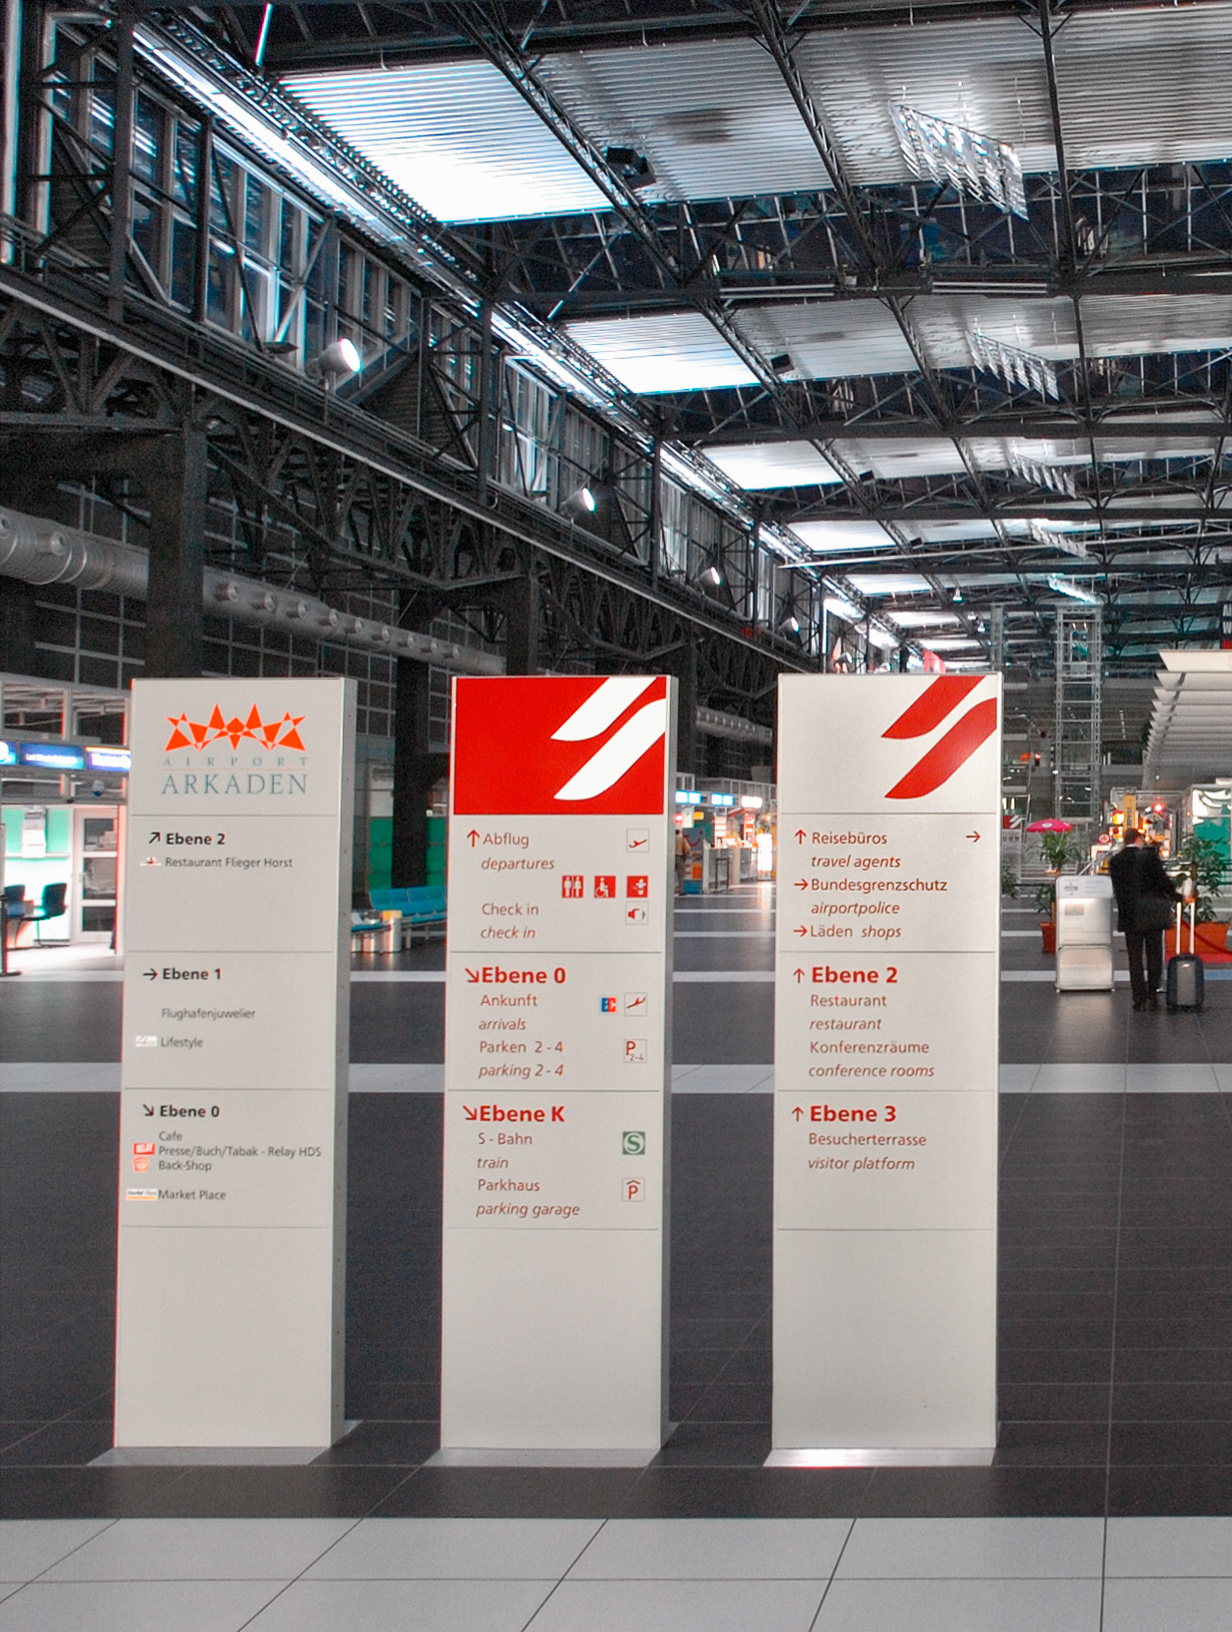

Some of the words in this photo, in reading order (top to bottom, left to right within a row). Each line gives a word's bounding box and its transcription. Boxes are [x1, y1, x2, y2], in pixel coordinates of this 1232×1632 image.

[163, 757, 307, 766] AIRPORT
[162, 774, 307, 794] ARKADEN
[166, 833, 212, 845] Ebene
[217, 833, 225, 845] 2
[483, 832, 529, 849] Abflug
[812, 832, 887, 844] Reisebüros
[165, 857, 222, 867] Restaurant
[226, 857, 260, 870] Flieger
[264, 858, 292, 867] Horst
[481, 857, 554, 872] departures
[812, 855, 851, 867] travel
[854, 857, 901, 871] agents
[812, 878, 947, 894] Bundesgrenzschutz
[482, 903, 522, 916] Check
[527, 903, 538, 915] in
[811, 901, 900, 917] airportpolice
[481, 926, 519, 939] check
[523, 927, 535, 938] in
[811, 925, 853, 937] Läden
[862, 925, 901, 940] shops
[163, 968, 209, 980] Ebene
[215, 968, 221, 979] 1
[483, 966, 547, 983] Ebene
[554, 968, 566, 983] 0
[812, 966, 879, 983] Ebene
[886, 967, 897, 983] 2
[480, 994, 537, 1006] Ankunft
[811, 995, 886, 1007] Restaurant
[162, 1008, 256, 1021] Flughafenjuwelier
[479, 1018, 526, 1030] arrivals
[810, 1019, 881, 1030] restaurant
[161, 1037, 203, 1049] Lifestyle
[480, 1041, 526, 1053] Parken
[535, 1041, 542, 1053] 2
[555, 1041, 563, 1052] 4
[811, 1040, 929, 1053] Konferenzräume
[478, 1064, 531, 1080] parking
[535, 1064, 543, 1076] 2
[555, 1064, 563, 1076] 4
[809, 1064, 887, 1077] conference
[891, 1067, 934, 1077] rooms
[160, 1105, 206, 1117] Ebene
[211, 1106, 220, 1117] 0
[480, 1105, 545, 1122] Ebene
[552, 1106, 565, 1122] K
[811, 1105, 877, 1122] Ebene
[885, 1106, 896, 1122] 3
[159, 1131, 183, 1141] Cafe
[478, 1132, 485, 1144] S
[498, 1133, 532, 1144] Bahn
[809, 1133, 926, 1146] Besucherterrasse
[159, 1146, 258, 1158] Presse/Buch/Tabak
[268, 1146, 296, 1159] Relay
[299, 1147, 321, 1157] HDS
[159, 1160, 212, 1172] Back-Shop
[478, 1157, 508, 1168] train
[808, 1157, 850, 1169] visitor
[853, 1157, 915, 1172] platform
[478, 1179, 540, 1191] Parkhaus
[158, 1190, 195, 1199] Market
[199, 1190, 226, 1200] Place
[476, 1203, 528, 1218] parking
[533, 1206, 580, 1218] garage
